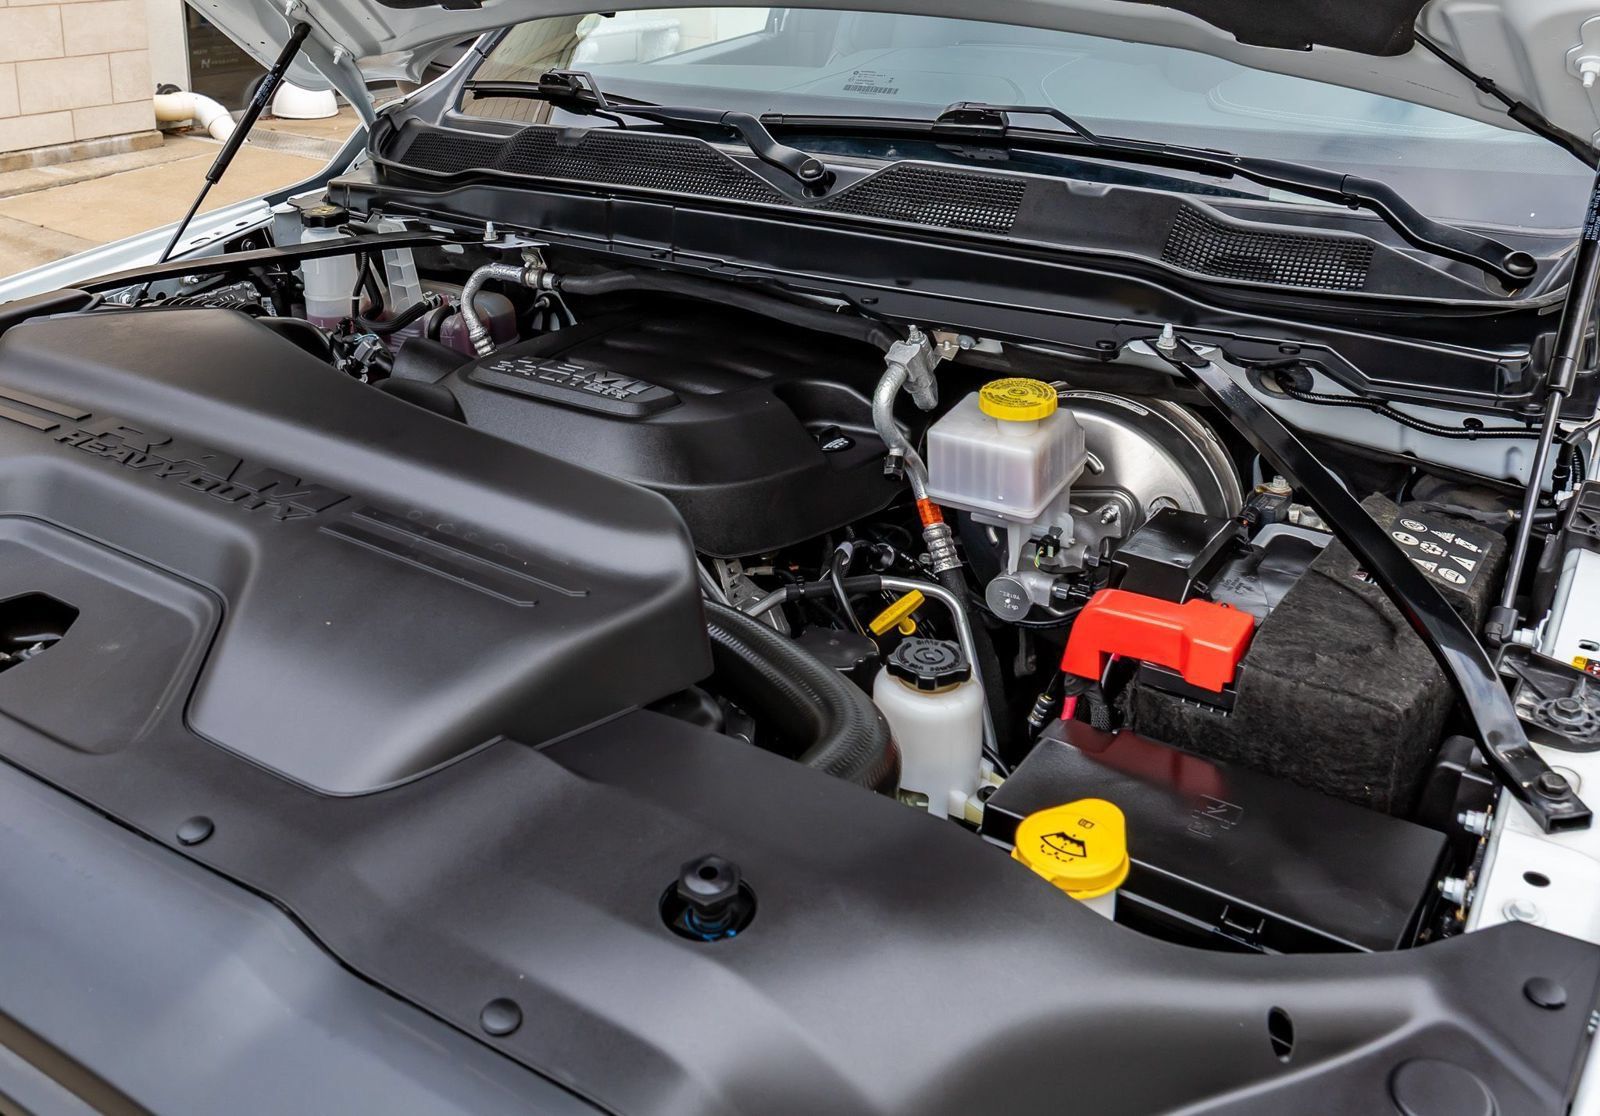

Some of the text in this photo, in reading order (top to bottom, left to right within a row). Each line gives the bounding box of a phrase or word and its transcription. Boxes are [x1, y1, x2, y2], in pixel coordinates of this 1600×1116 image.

[54, 432, 316, 521] HEAVY DUTY
[78, 416, 351, 513] RAM
